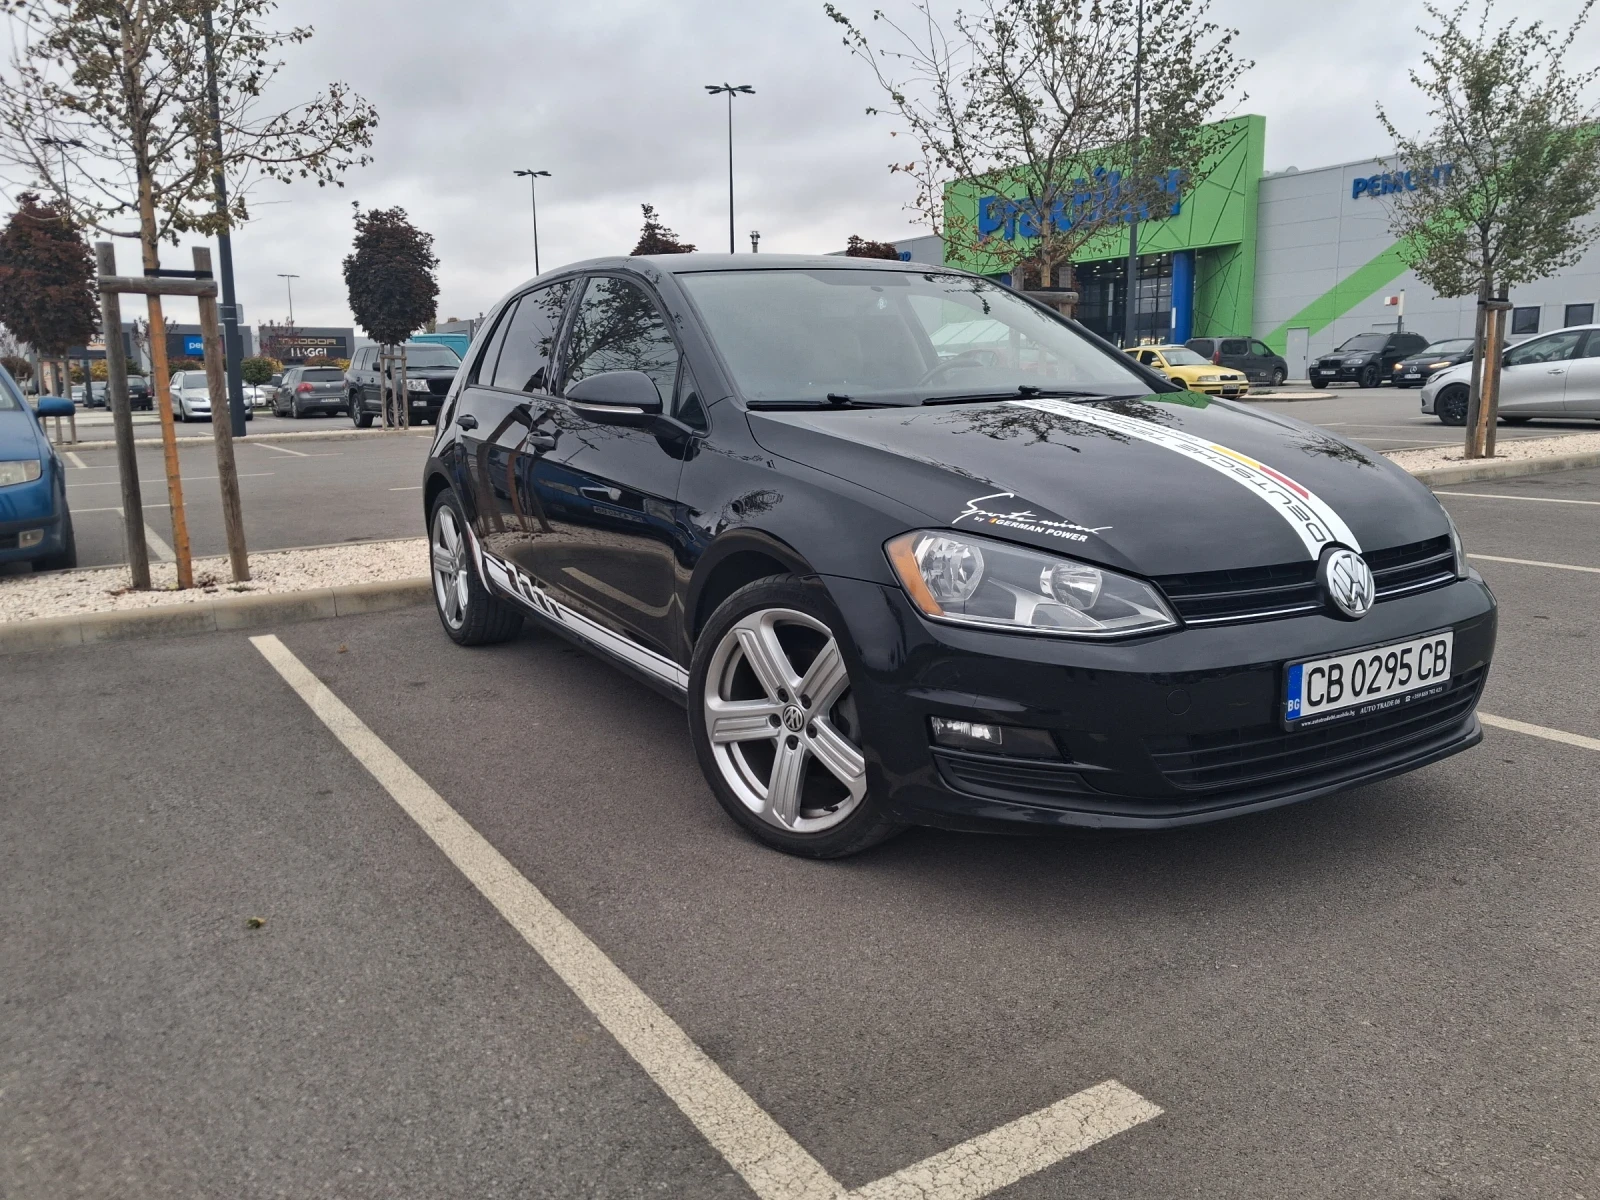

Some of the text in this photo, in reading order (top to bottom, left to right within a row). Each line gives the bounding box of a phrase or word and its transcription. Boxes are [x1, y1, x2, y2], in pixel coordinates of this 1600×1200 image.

[1175, 443, 1327, 542] DEUTSCHE
[995, 519, 1045, 533] GERMAN
[1045, 529, 1088, 542] POWER
[1306, 639, 1447, 707] CB 0295 CB
[1287, 698, 1300, 712] BG
[1359, 704, 1377, 715] AUTO
